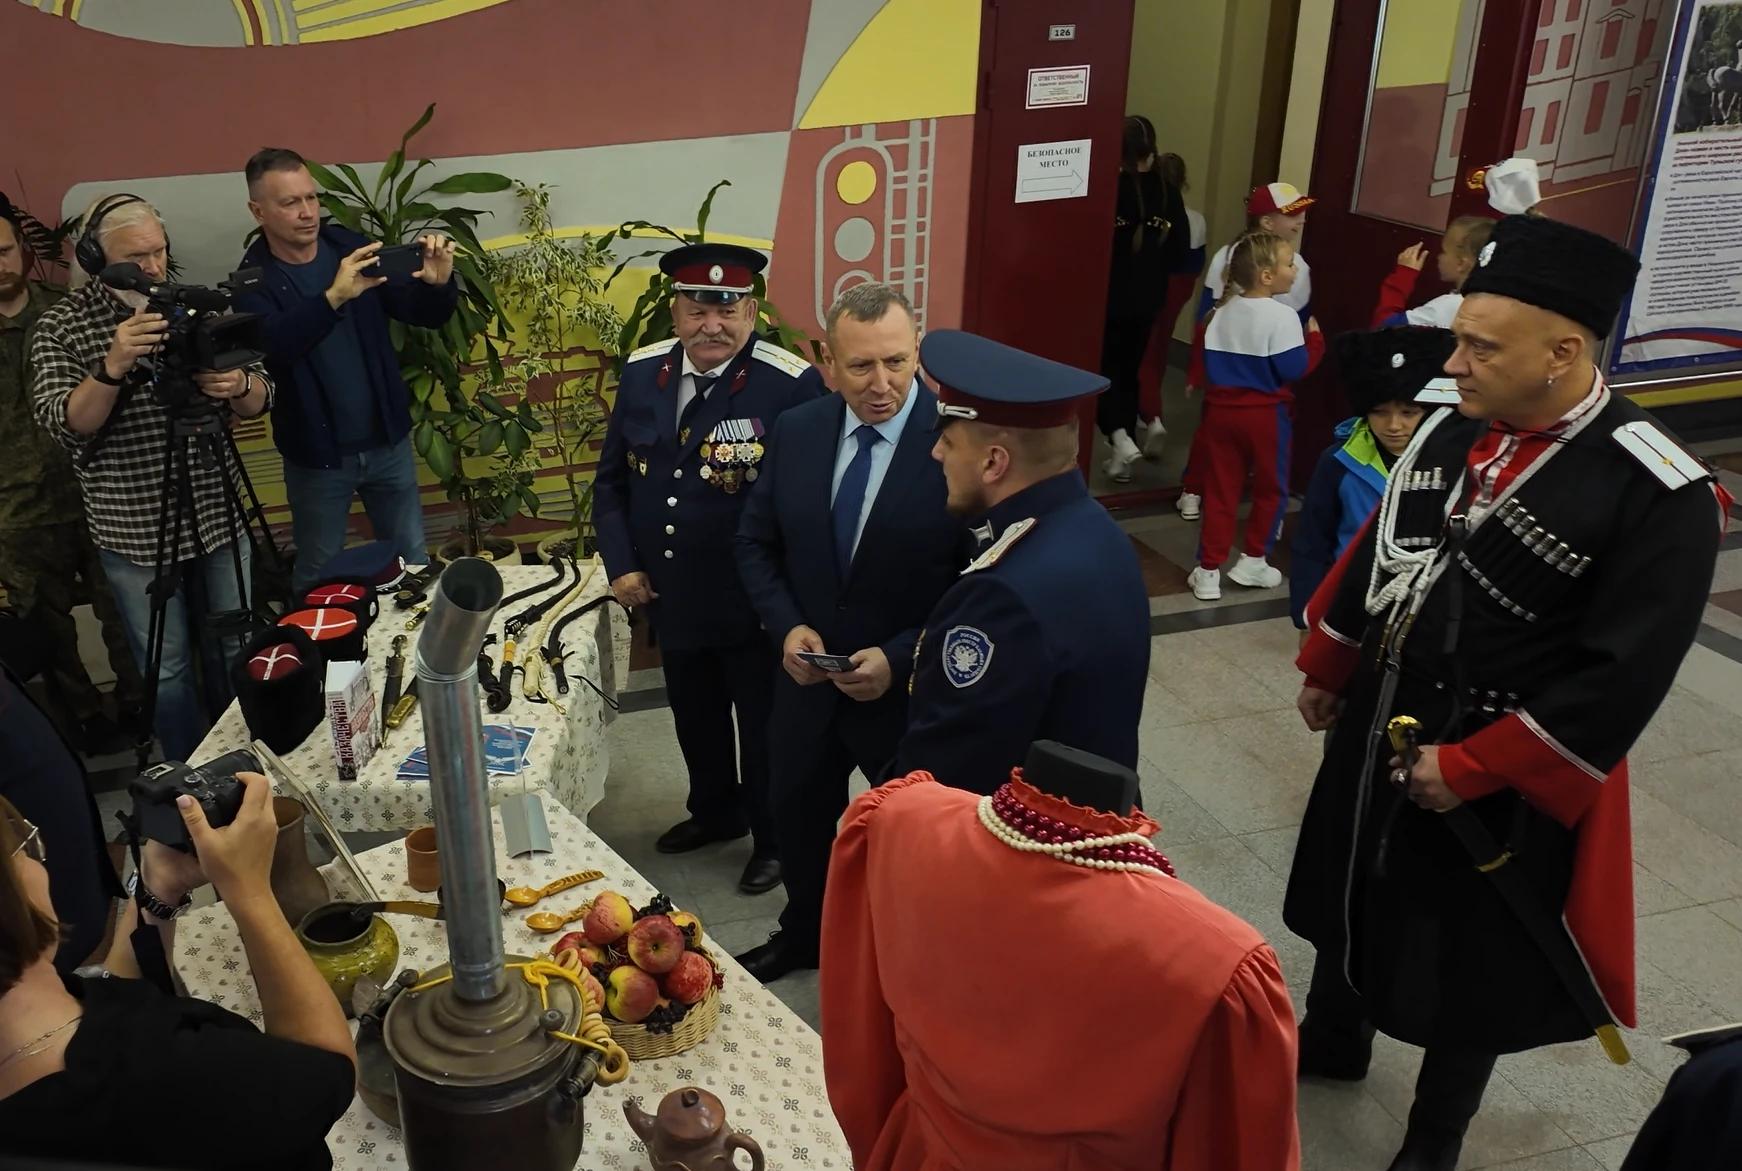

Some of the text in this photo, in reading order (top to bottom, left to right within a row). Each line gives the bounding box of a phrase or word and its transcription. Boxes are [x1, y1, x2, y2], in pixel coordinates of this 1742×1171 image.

[1054, 28, 1071, 37] 126
[1027, 146, 1082, 158] БЕЗОПАСНОЕ
[1039, 159, 1069, 168] МЕСТО
[332, 700, 354, 761] КАЗАЧЕСТВА
